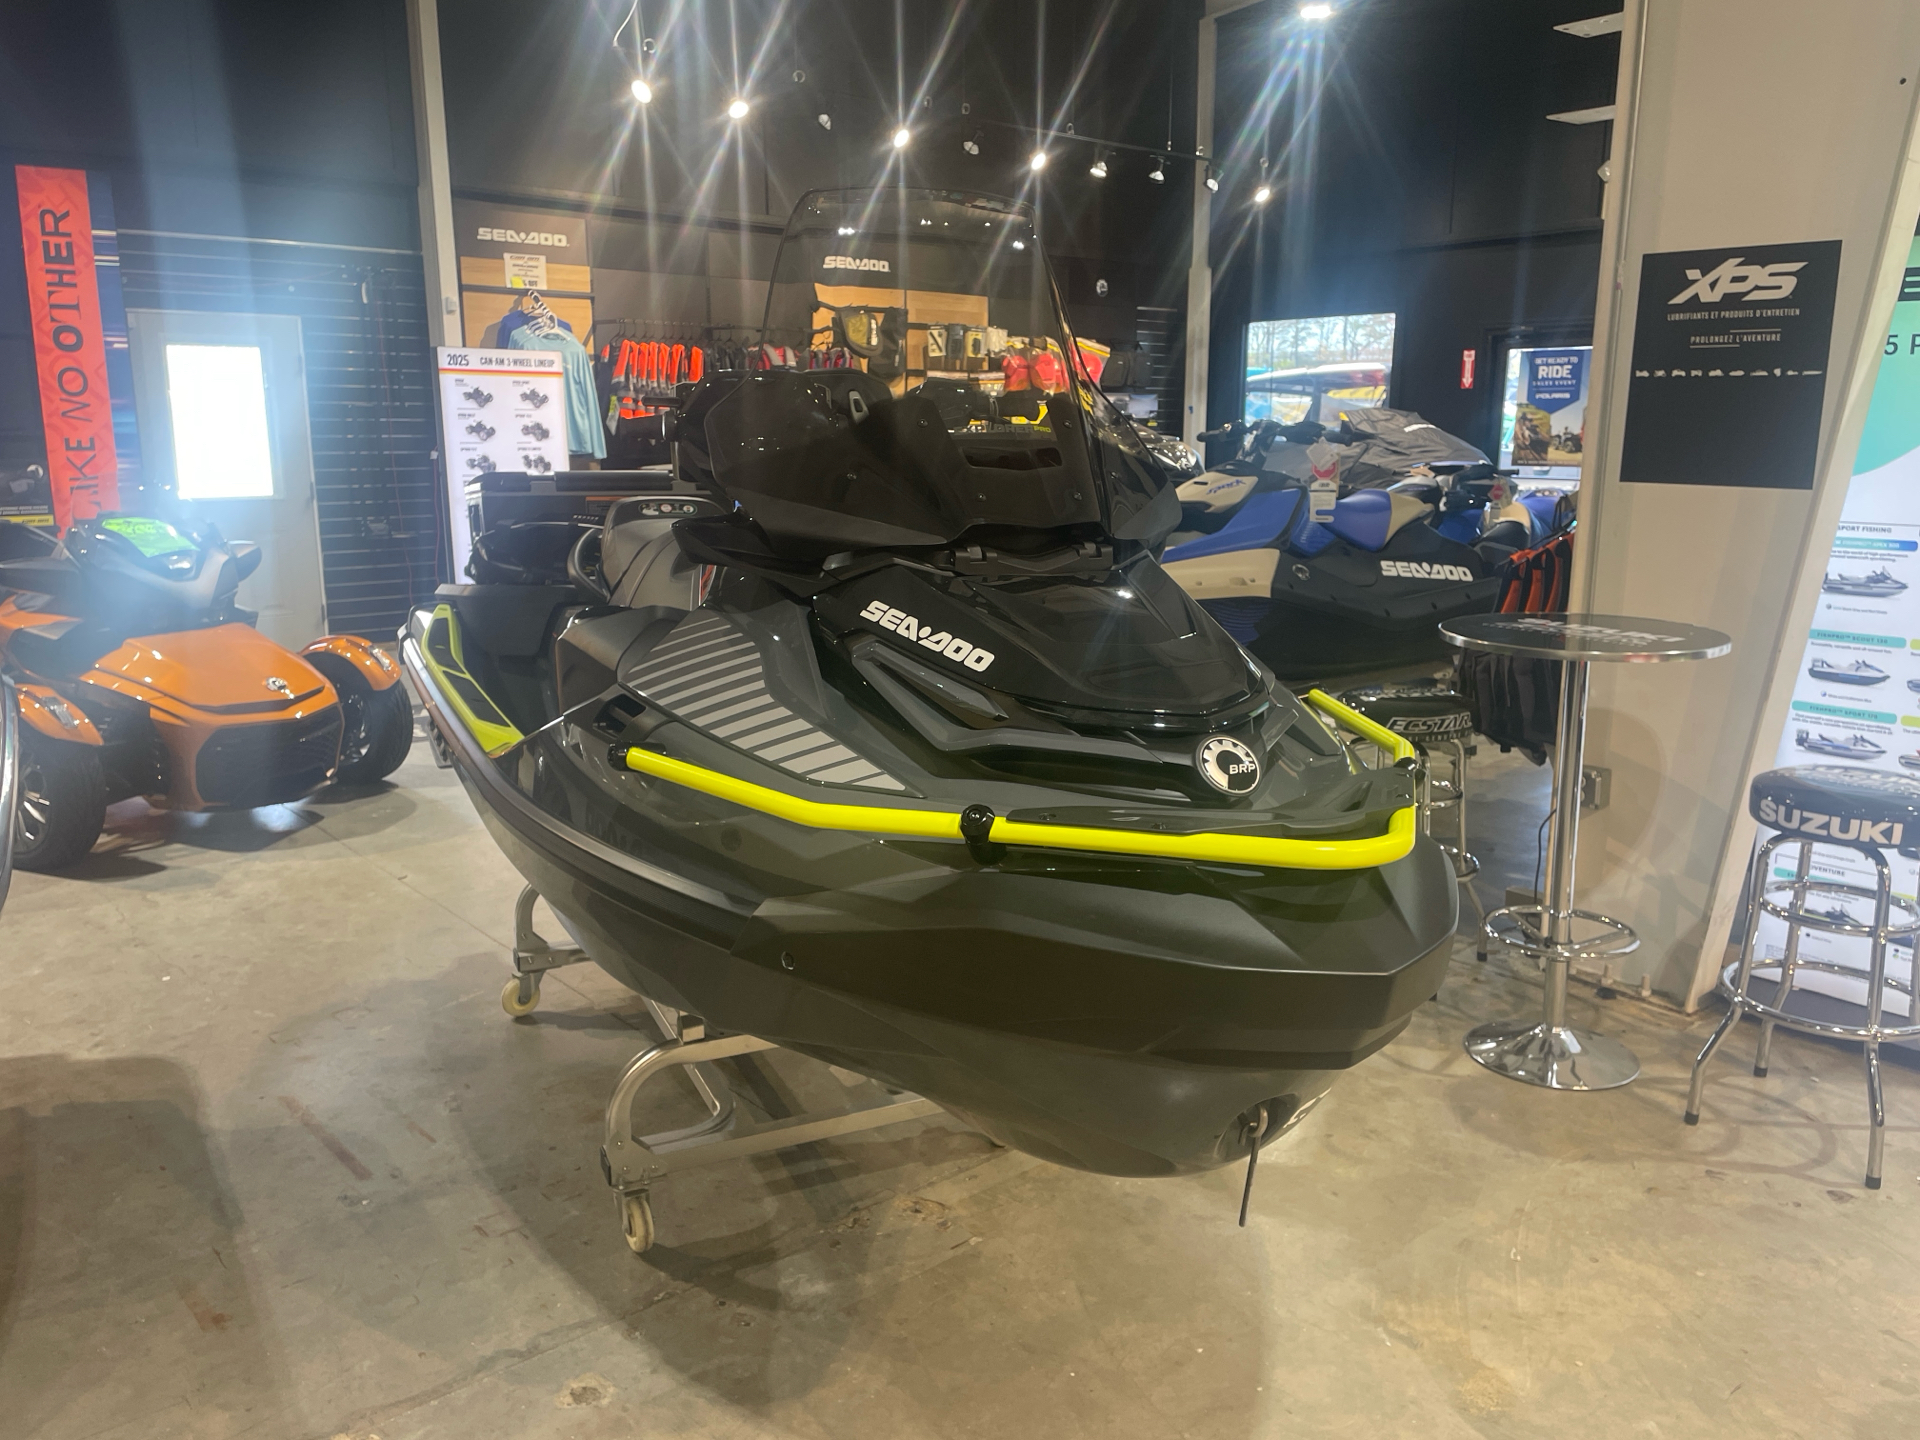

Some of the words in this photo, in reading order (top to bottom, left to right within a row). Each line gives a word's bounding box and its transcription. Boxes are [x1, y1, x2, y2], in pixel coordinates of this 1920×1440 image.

[39, 207, 84, 353] OTHER
[1667, 257, 1809, 304] XPS
[1667, 312, 1709, 321] LUBRIFIANTS
[1710, 311, 1719, 319] ET
[1720, 310, 1753, 319] PRODUITS
[1755, 308, 1800, 317] D'ENTRETIEN
[1690, 335, 1733, 344] PROLONGEZ
[1736, 333, 1781, 342] L'AVENTURE
[447, 354, 469, 367] 2025
[1538, 365, 1572, 379] RIDE
[57, 366, 93, 423] NO
[1034, 425, 1051, 433] PRO
[1386, 711, 1472, 733] ECSTAR
[1229, 763, 1257, 775] BRP
[1759, 800, 1904, 845] SUZUKI
[1811, 864, 1846, 877] VENTURE
